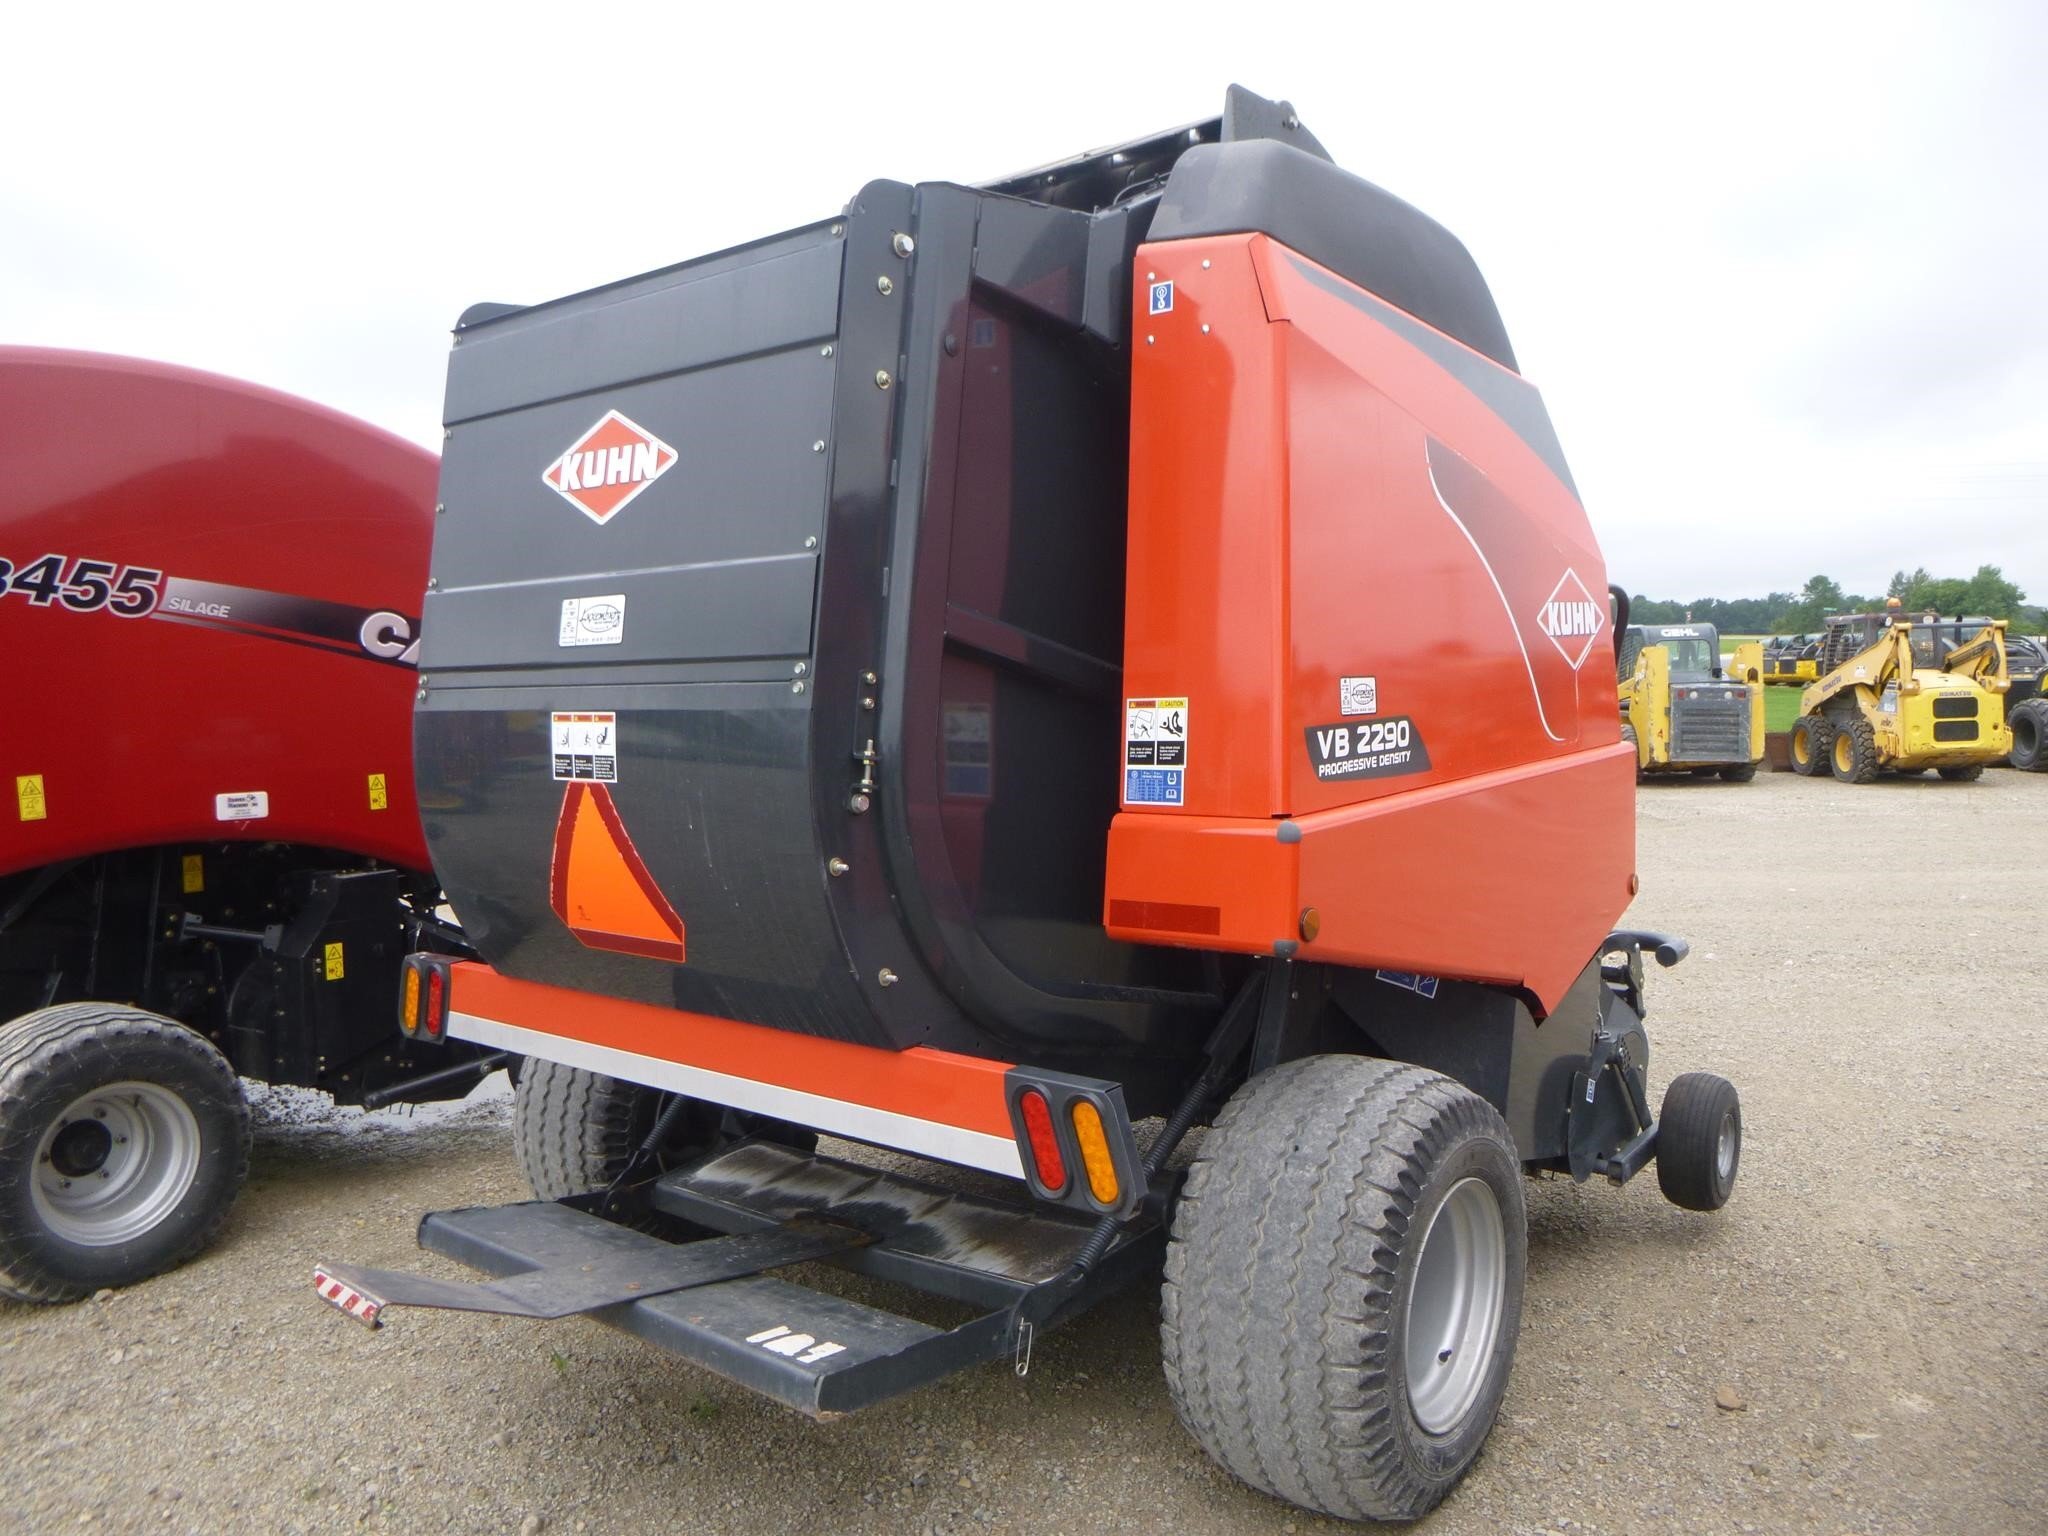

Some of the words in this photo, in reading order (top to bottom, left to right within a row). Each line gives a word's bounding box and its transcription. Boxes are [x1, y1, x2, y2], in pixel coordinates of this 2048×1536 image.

[559, 440, 659, 492] KUHN
[168, 598, 231, 618] SILAGE
[1547, 601, 1596, 637] KUHN
[1660, 628, 1700, 638] GEHL
[1316, 728, 1351, 760] VB
[1356, 720, 1410, 754] 2290
[1318, 756, 1378, 777] PROGRESSIVE
[1379, 750, 1412, 767] DENSITY
